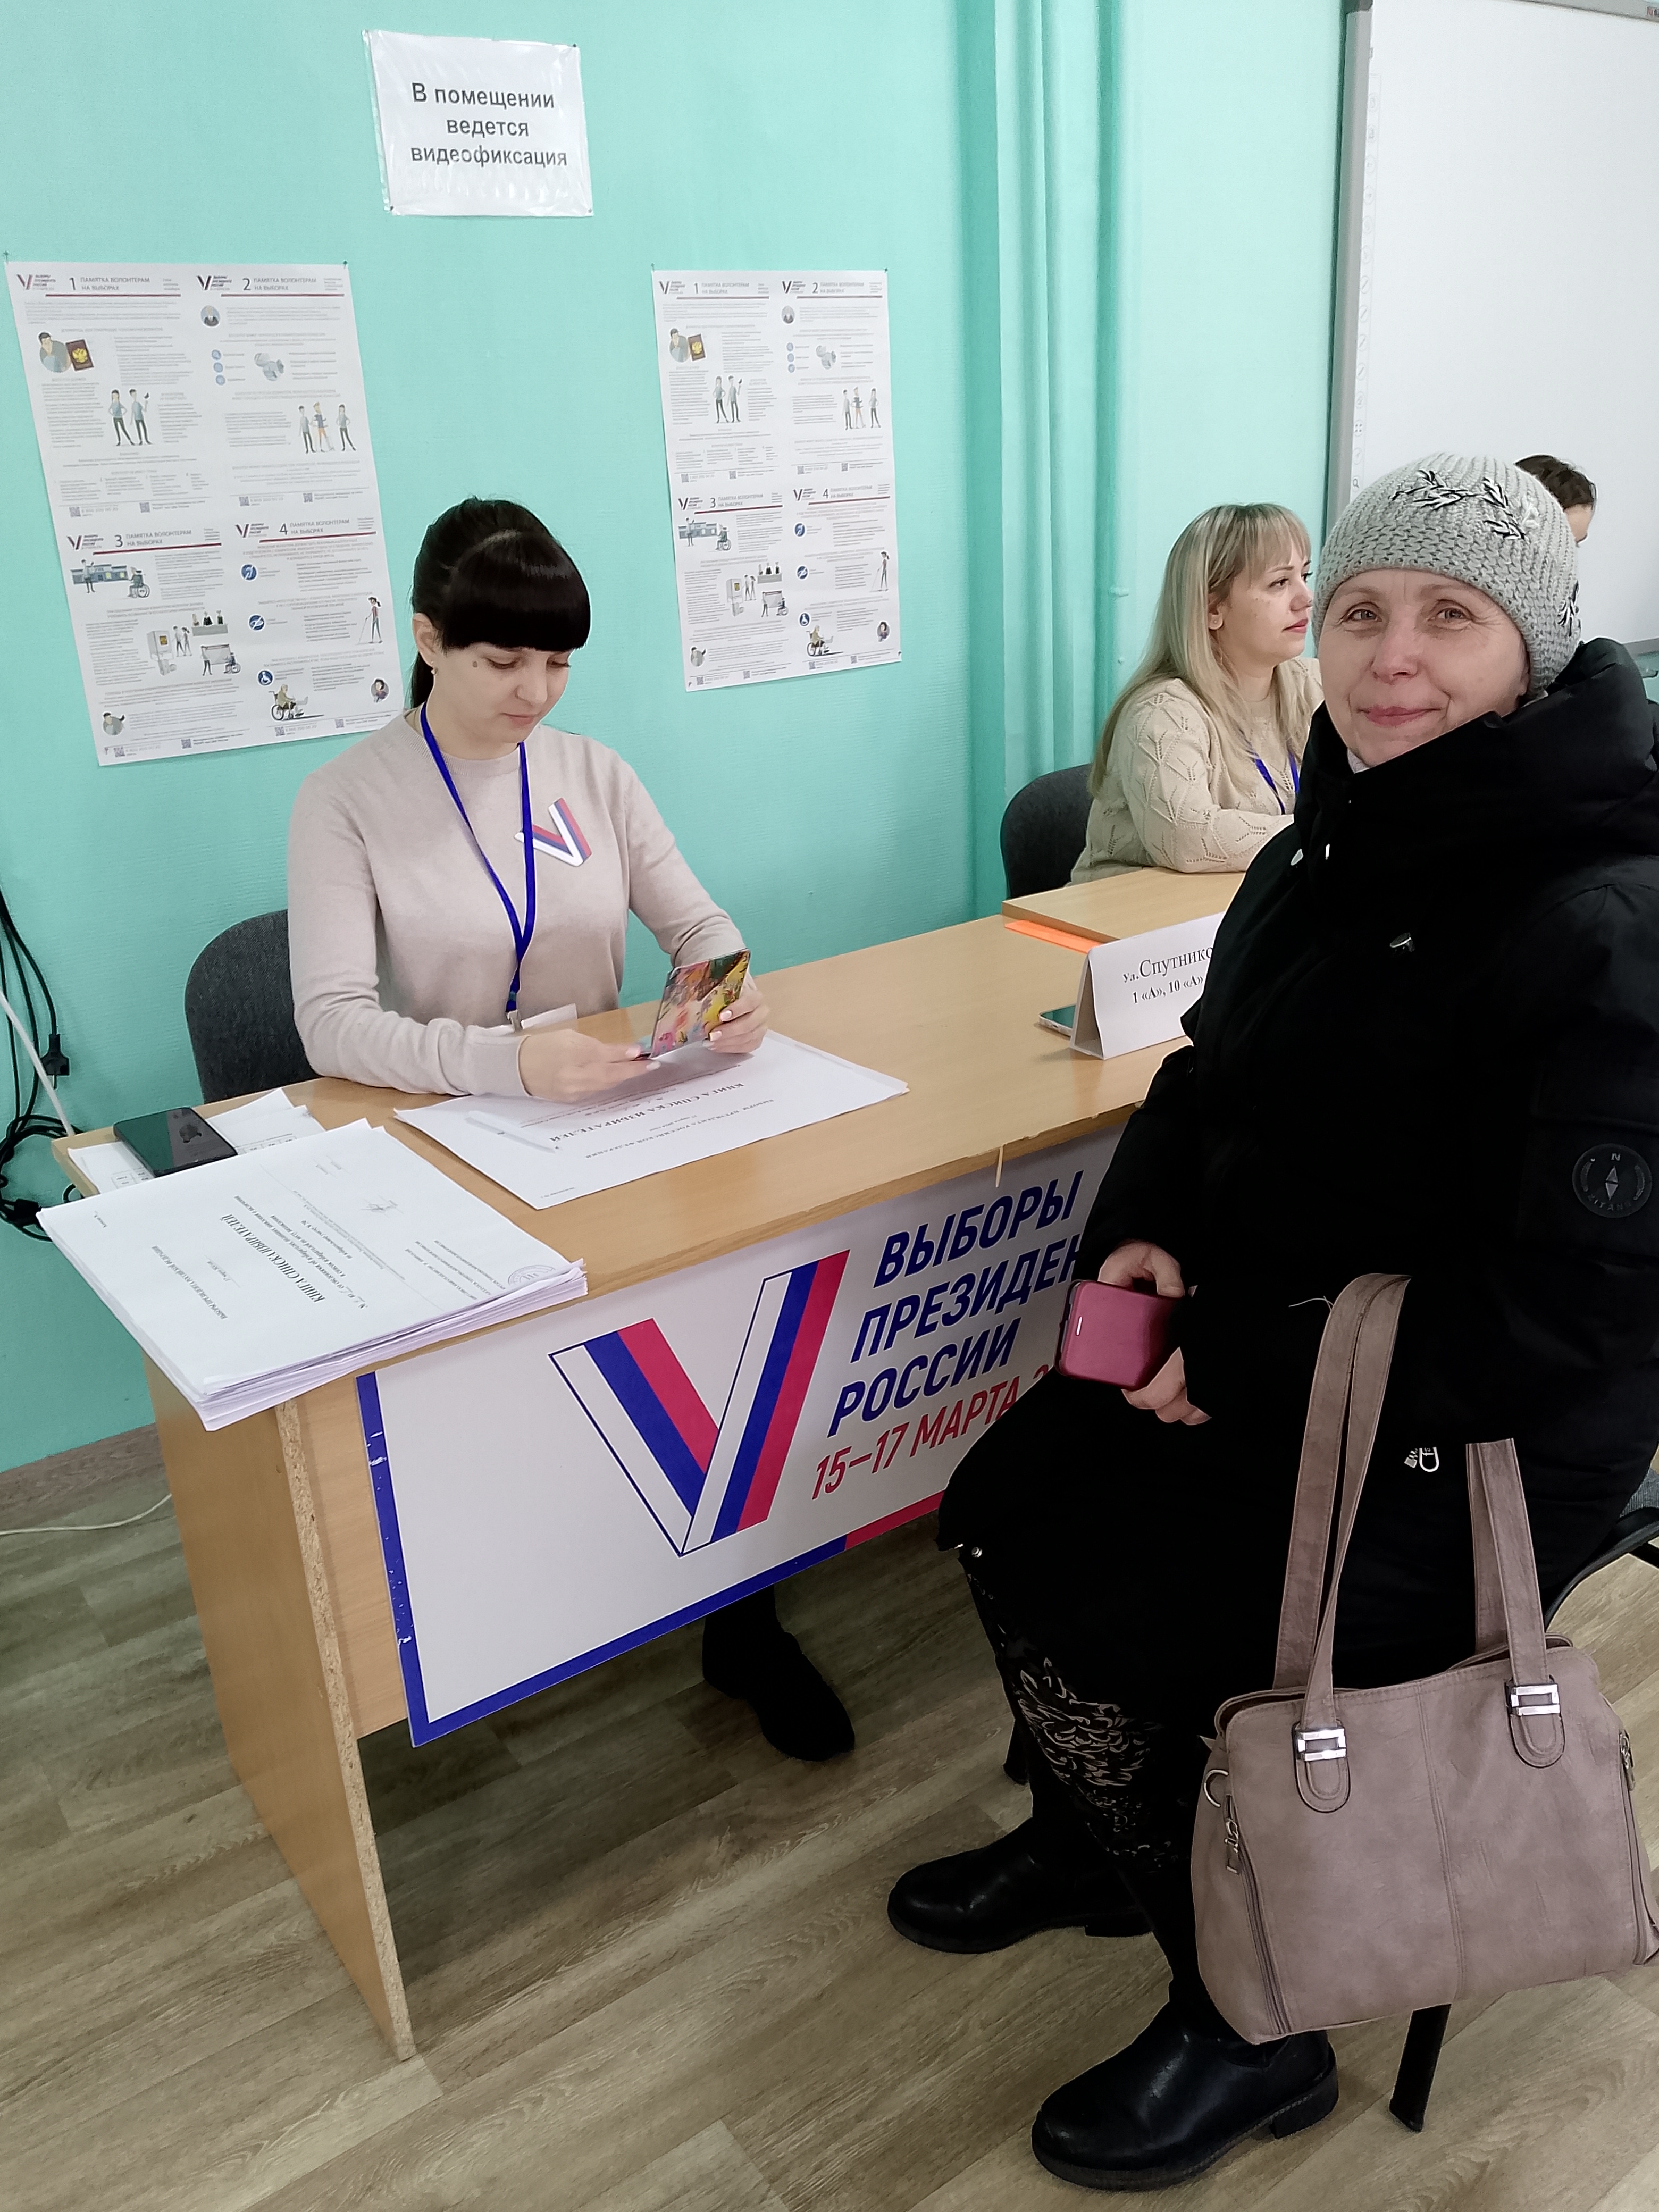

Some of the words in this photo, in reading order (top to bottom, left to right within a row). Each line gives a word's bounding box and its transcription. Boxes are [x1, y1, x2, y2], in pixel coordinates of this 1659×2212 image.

[412, 82, 426, 103] В
[434, 88, 555, 110] помещении
[447, 119, 529, 138] ведется
[410, 145, 567, 168] видеофиксация
[1133, 992, 1137, 1003] 1
[1169, 980, 1180, 993] 10
[700, 1083, 744, 1097] КНИГА
[648, 1096, 701, 1111] СПИСКА
[217, 1213, 273, 1254] ИЗБИРАТЕЛЕЙ
[874, 1171, 1084, 1288] ВЫБОРЫ
[262, 1251, 303, 1280] СПИСКА
[290, 1277, 328, 1302] КНИГА
[827, 1318, 1021, 1438] РОССИИ
[909, 1380, 1018, 1459] МАРТА
